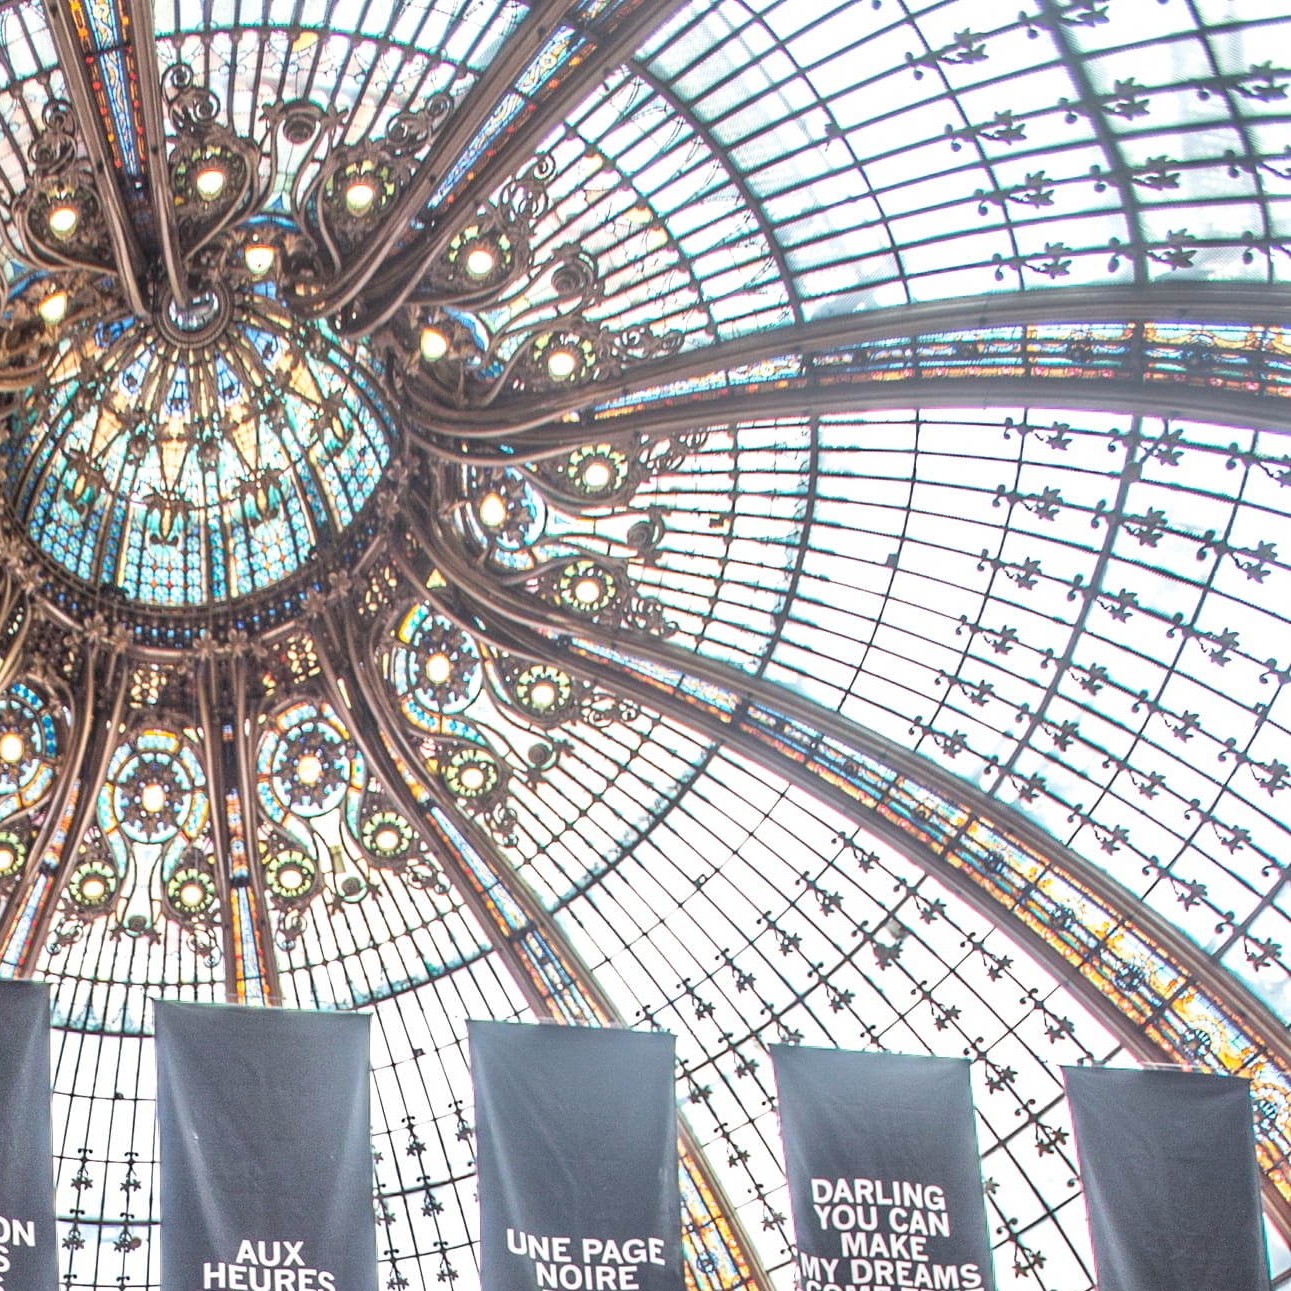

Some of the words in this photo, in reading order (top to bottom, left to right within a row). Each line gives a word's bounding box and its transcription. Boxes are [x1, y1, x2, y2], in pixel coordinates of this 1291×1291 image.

[236, 1240, 305, 1267] AUX
[507, 1228, 571, 1262] UNE
[582, 1238, 665, 1265] PAGE
[535, 1262, 639, 1290] NOIRE
